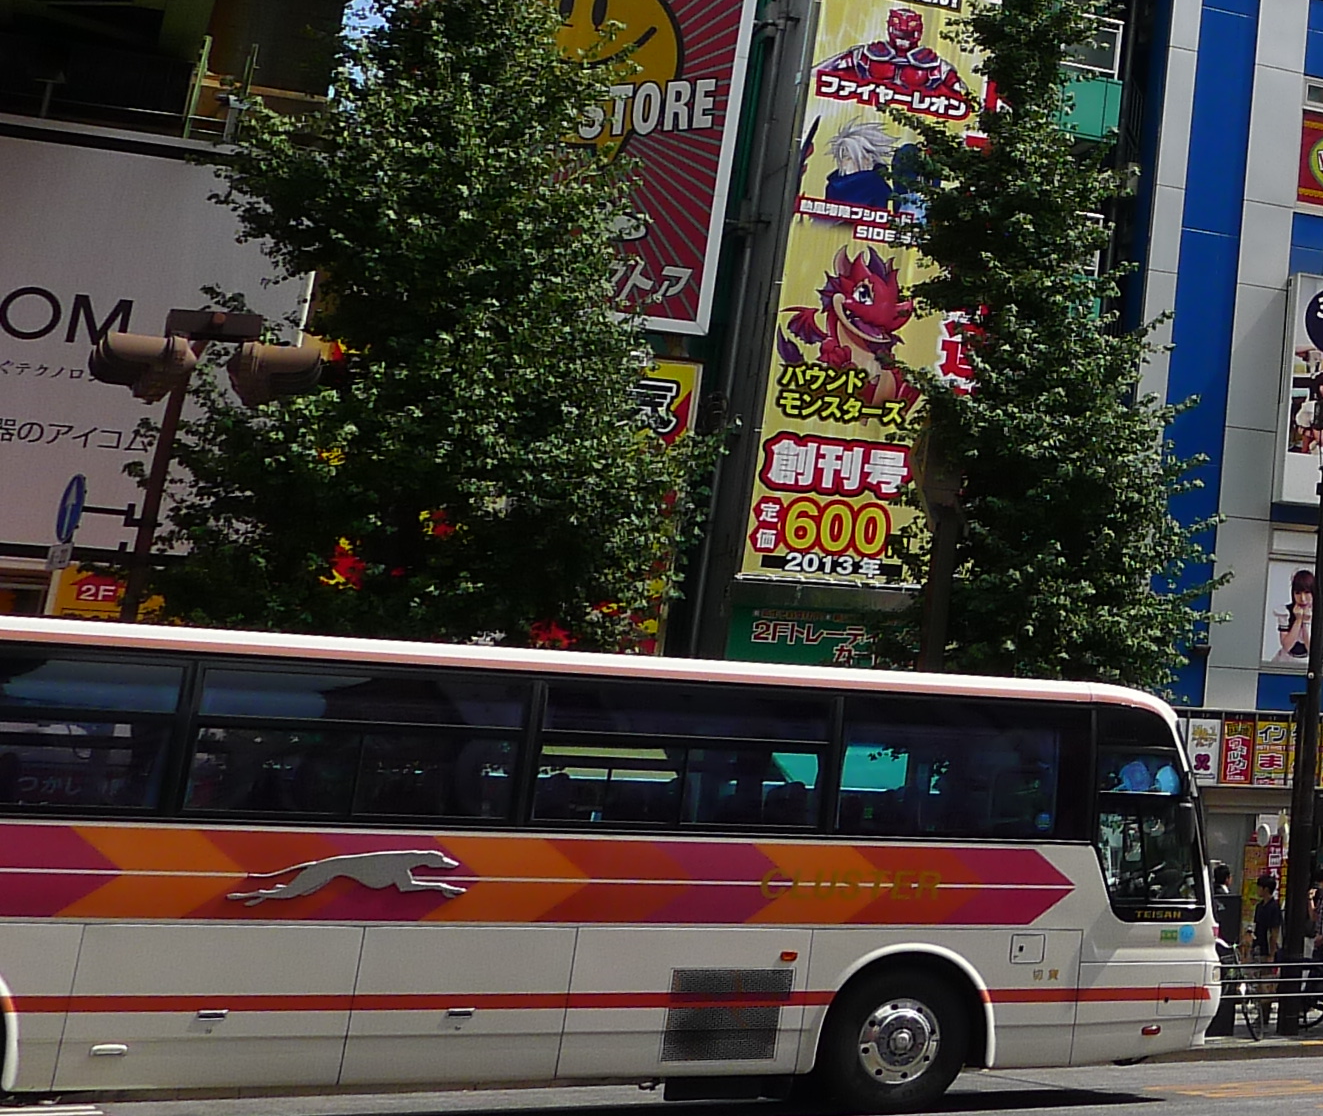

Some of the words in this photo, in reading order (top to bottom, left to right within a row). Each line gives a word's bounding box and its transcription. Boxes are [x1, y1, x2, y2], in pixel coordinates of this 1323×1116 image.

[818, 73, 967, 118] ファイヤーレオン
[780, 364, 867, 395] バウンド
[777, 391, 908, 425] モンスターズ
[766, 438, 909, 493] 創刊号
[782, 497, 888, 555] 600
[784, 550, 882, 579] 2013年
[79, 584, 117, 602] 2F
[760, 868, 942, 901] CLUSTER
[1135, 910, 1183, 920] TEISAN
